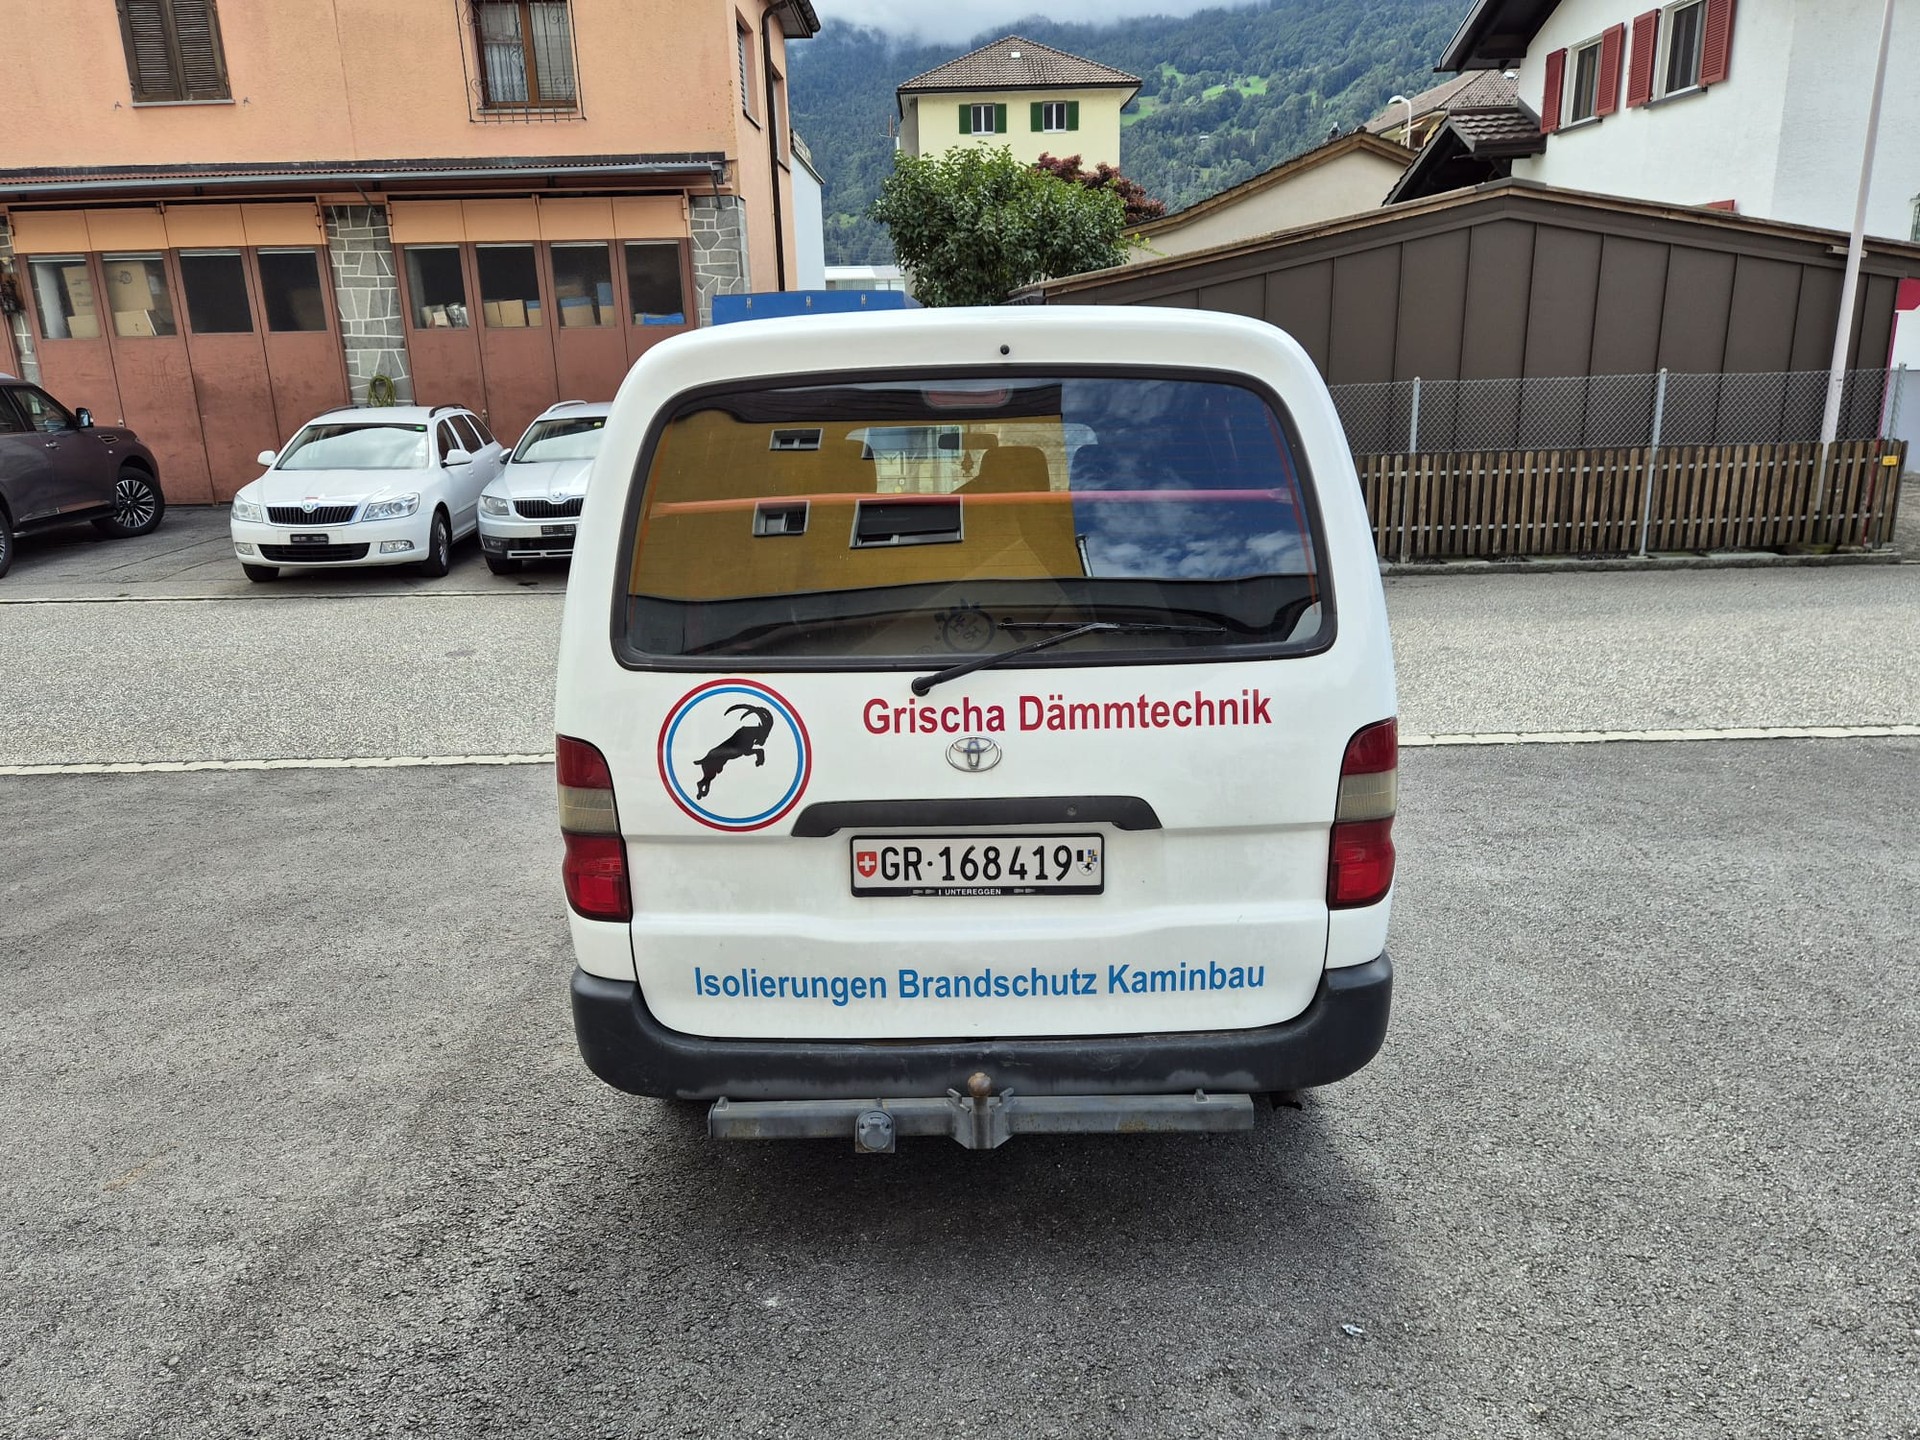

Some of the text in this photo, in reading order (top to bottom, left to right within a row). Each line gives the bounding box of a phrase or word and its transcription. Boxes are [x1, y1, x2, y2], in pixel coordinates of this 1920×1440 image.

[863, 689, 1272, 734] Grischa Dämmtechnik
[944, 888, 1001, 896] UNTEREGGEN
[694, 961, 1265, 1007] Isolierungen Brandschutz Kaminbau
